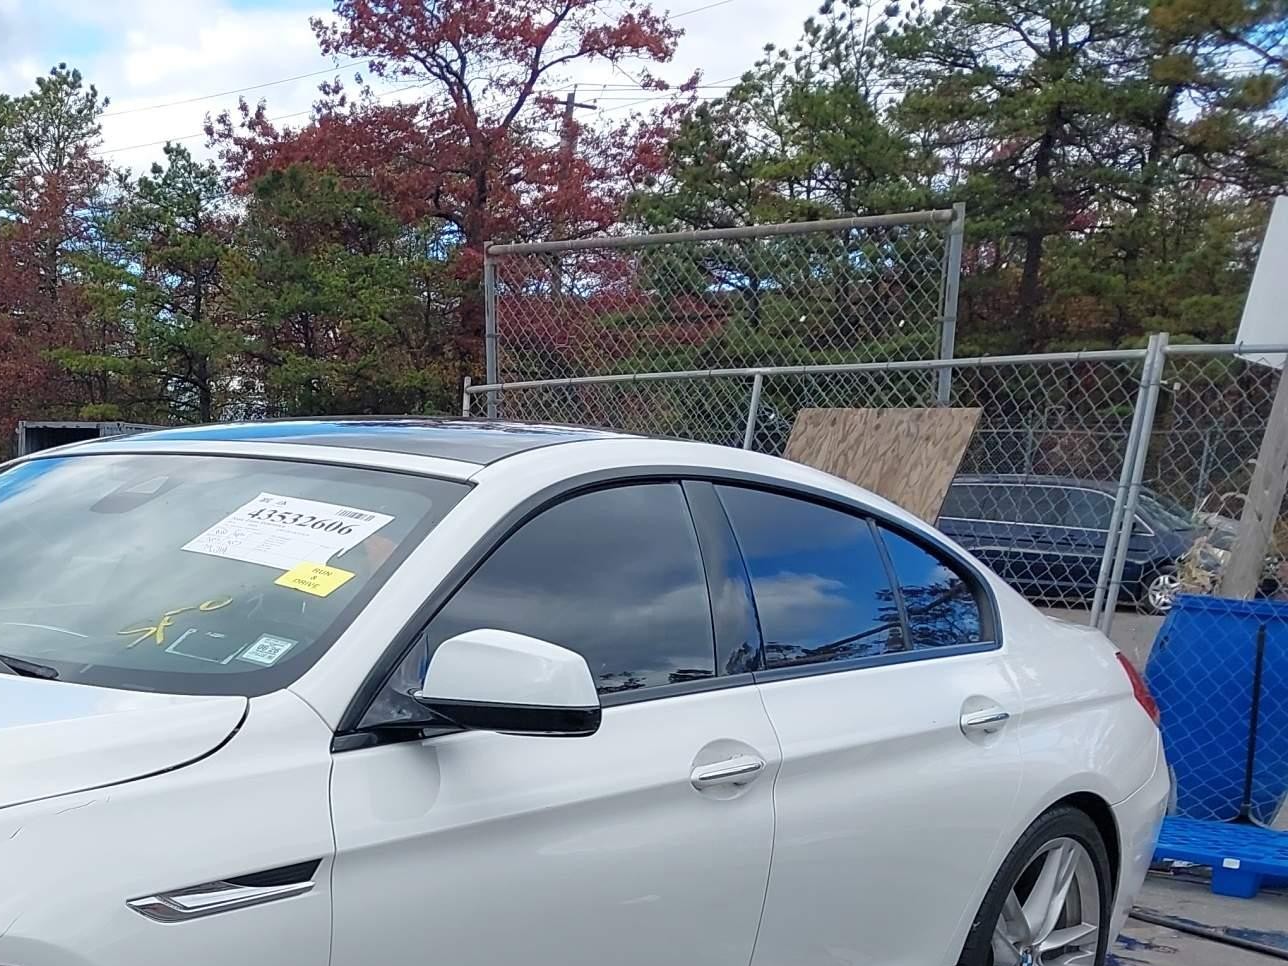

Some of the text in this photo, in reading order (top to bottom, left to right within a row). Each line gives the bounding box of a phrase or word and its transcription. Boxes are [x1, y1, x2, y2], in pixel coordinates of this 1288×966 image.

[247, 507, 360, 536] 43532606
[311, 567, 333, 577] RUN
[292, 578, 320, 590] DRIVE
